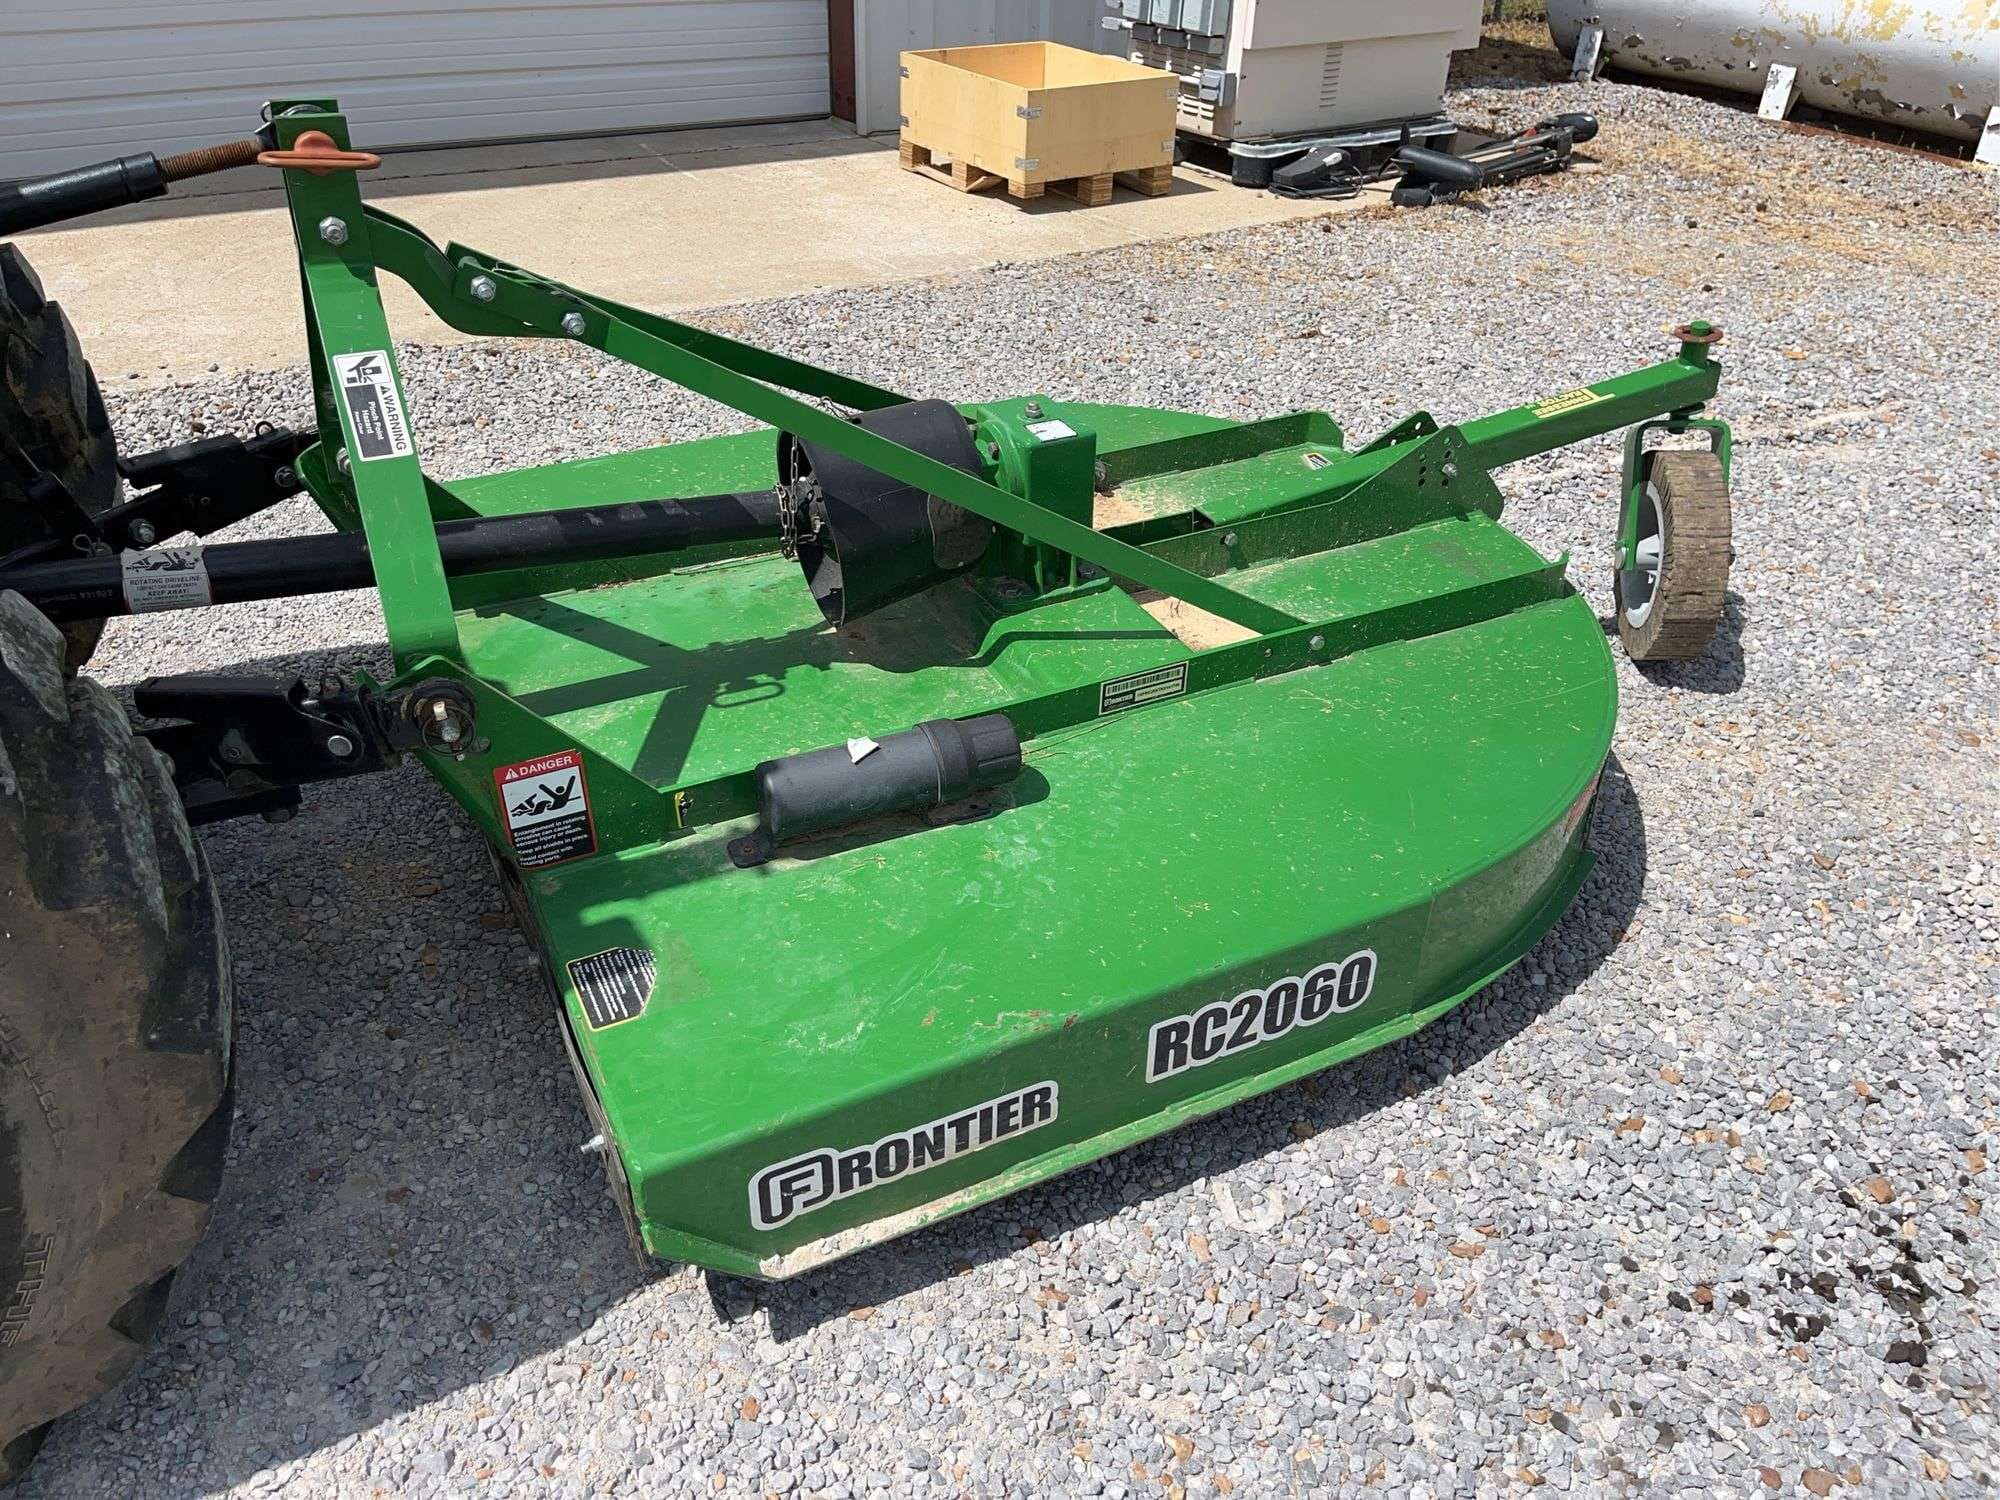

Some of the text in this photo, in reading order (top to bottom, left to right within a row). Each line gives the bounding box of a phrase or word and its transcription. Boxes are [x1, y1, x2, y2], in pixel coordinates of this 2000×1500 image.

[361, 409, 375, 434] Hazard
[367, 400, 385, 440] Pinch Point
[383, 394, 407, 451] WARNING
[130, 577, 163, 586] ROTATING
[519, 755, 573, 776] DANGER
[514, 822, 555, 837] Entanglement
[563, 815, 586, 825] rotating
[515, 832, 541, 842] driveline
[516, 839, 539, 847] serious
[540, 833, 557, 842] injury
[543, 840, 564, 849] shields
[537, 849, 560, 858] contact
[1153, 956, 1372, 1077] RC2060
[758, 1086, 1052, 1225] FRONTIER
